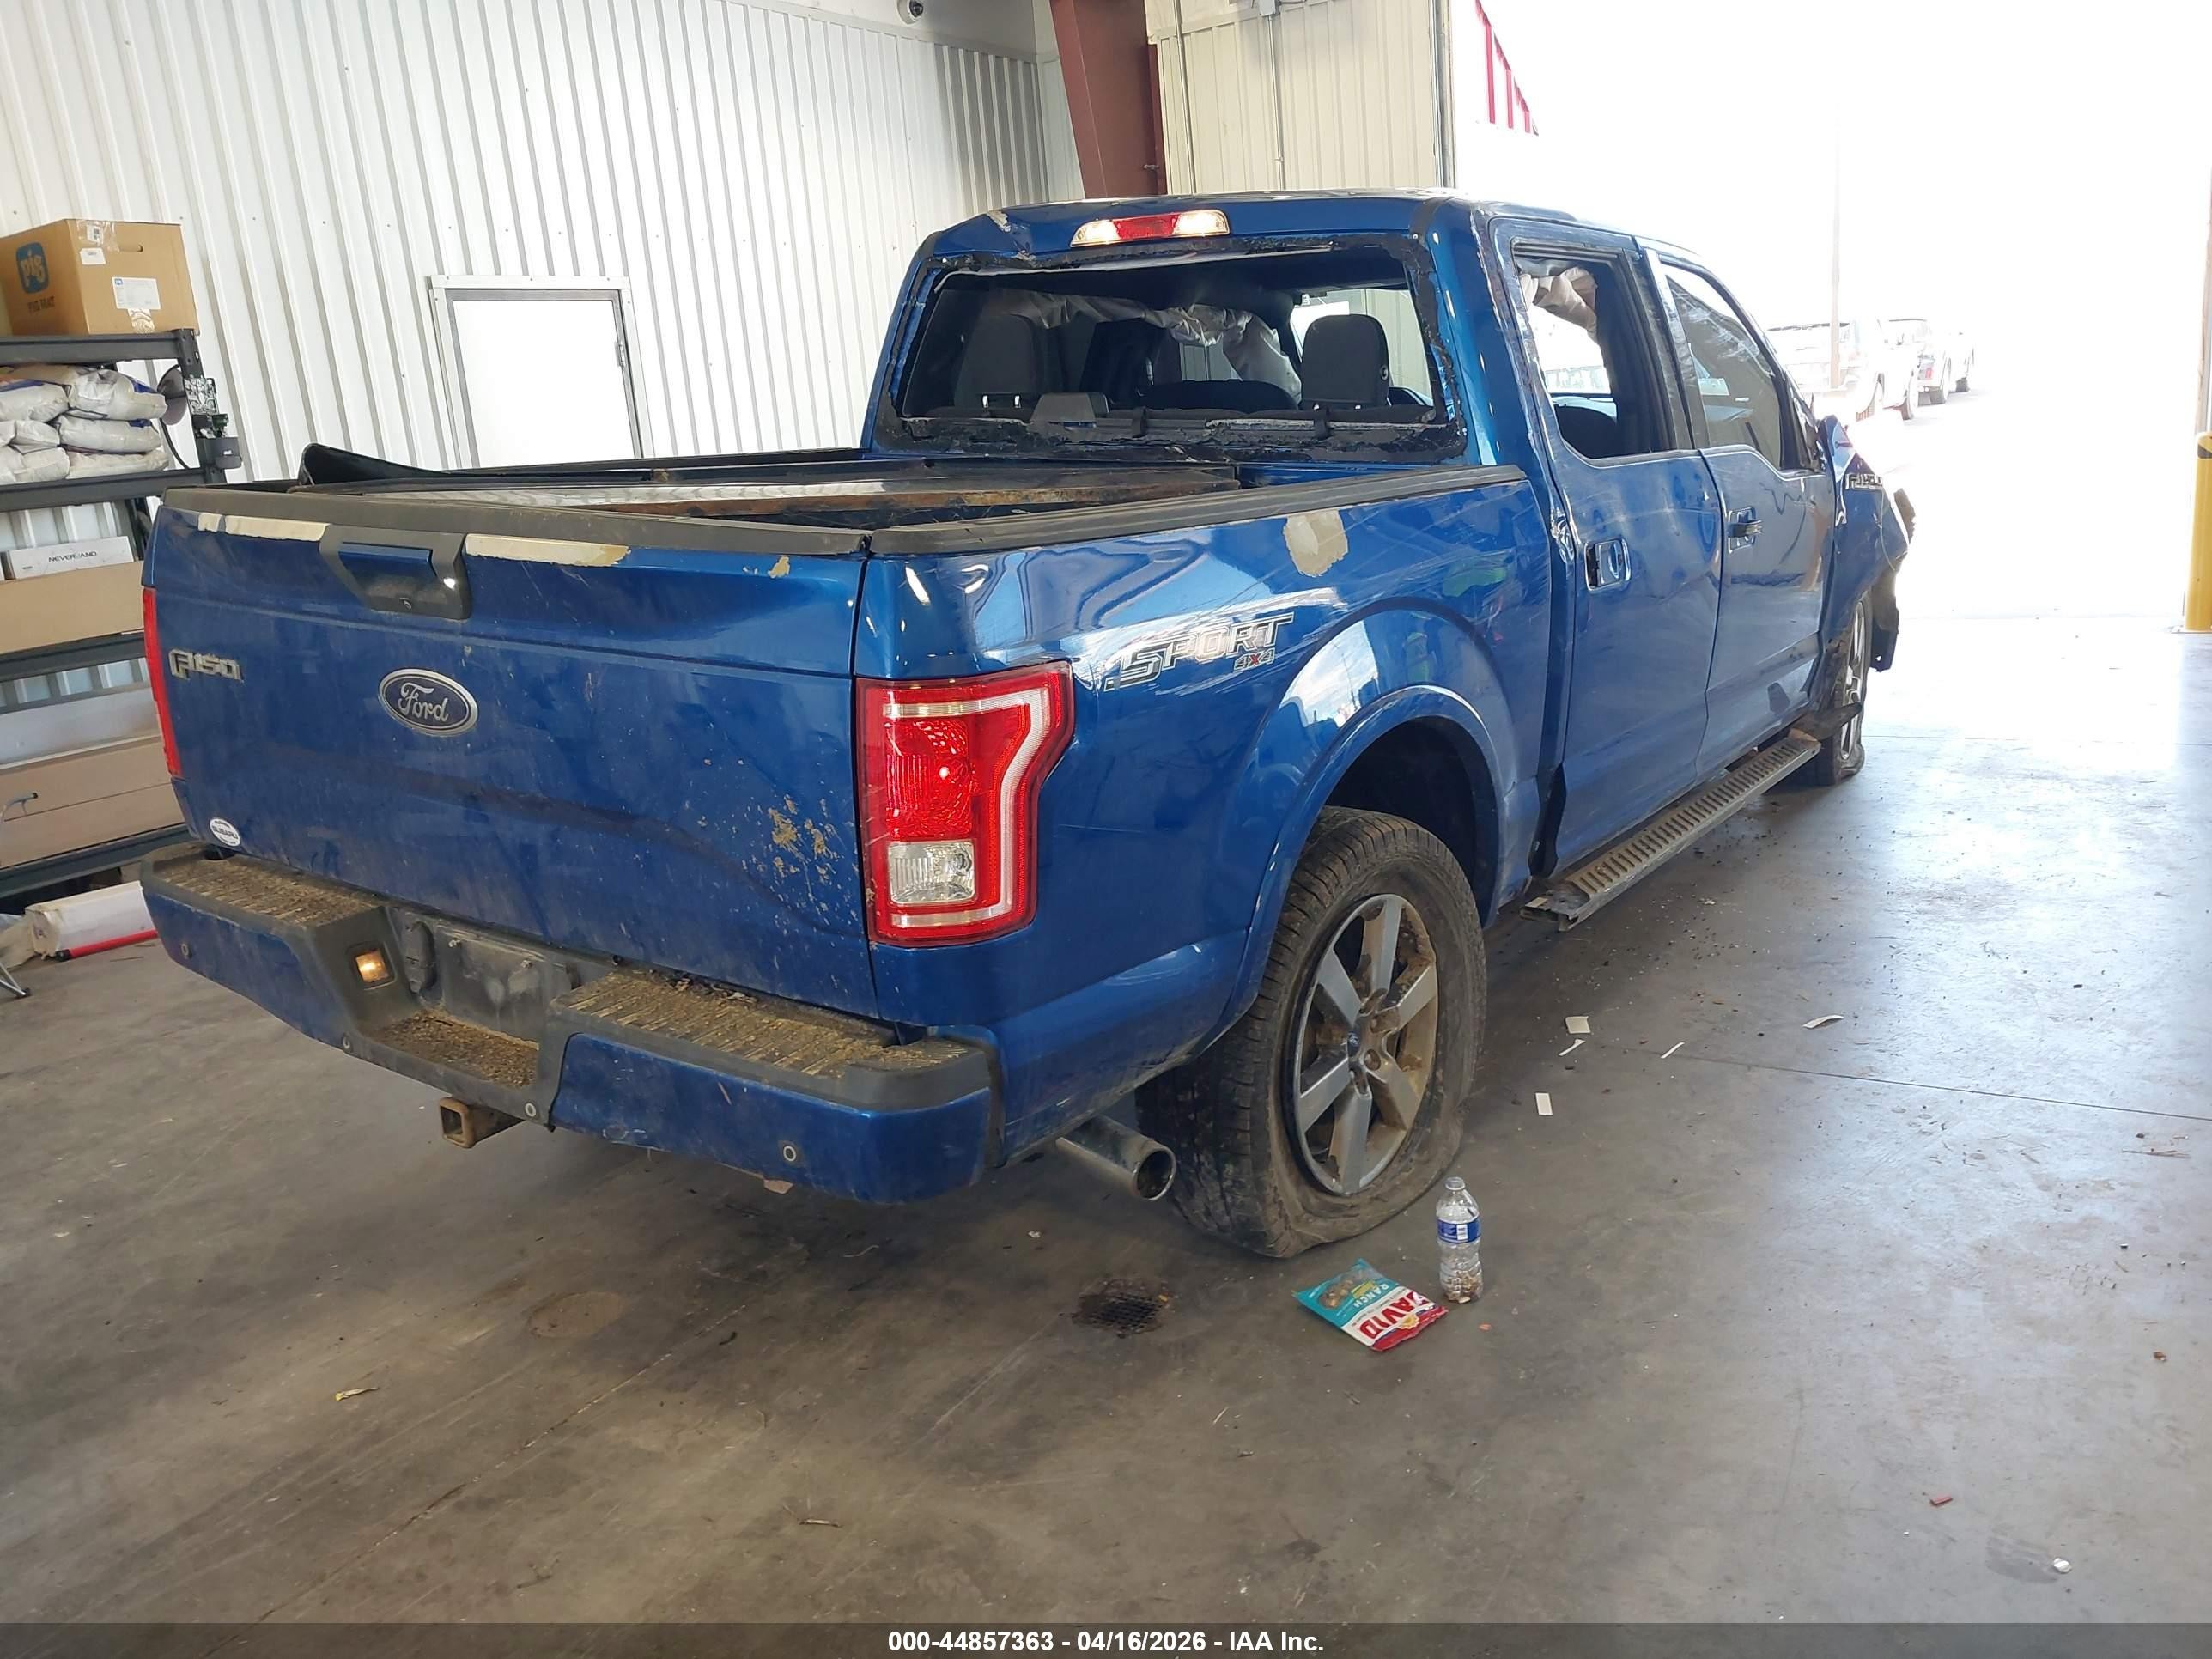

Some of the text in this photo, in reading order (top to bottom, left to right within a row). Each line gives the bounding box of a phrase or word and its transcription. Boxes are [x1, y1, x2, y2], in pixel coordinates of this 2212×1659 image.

[48, 550, 97, 563] NEVERAND
[1103, 611, 1295, 692] SPORT
[398, 682, 449, 721] Ford
[1352, 1283, 1390, 1308] RANCH
